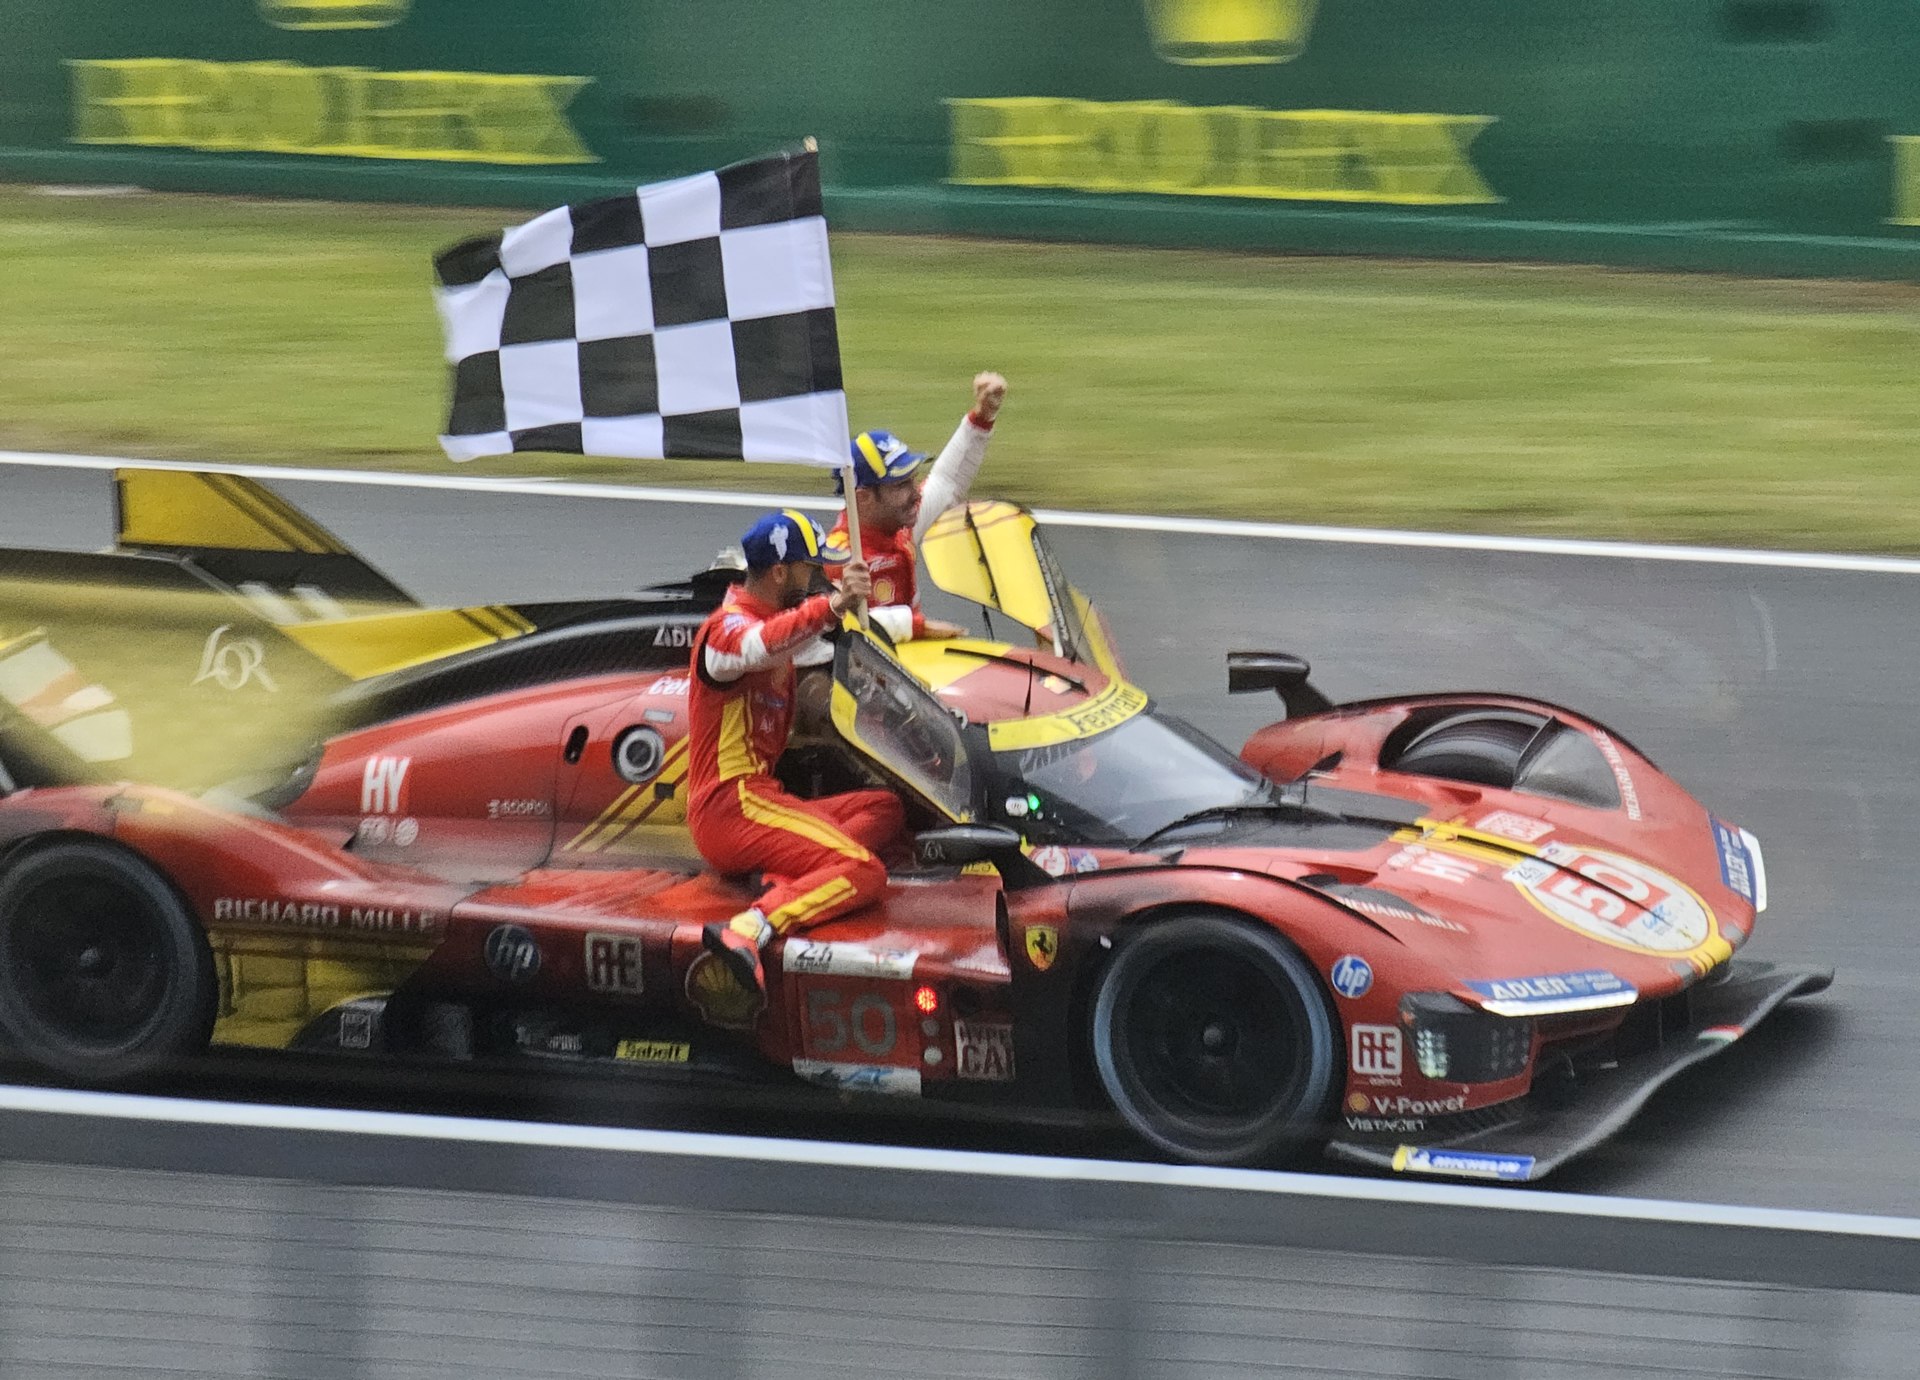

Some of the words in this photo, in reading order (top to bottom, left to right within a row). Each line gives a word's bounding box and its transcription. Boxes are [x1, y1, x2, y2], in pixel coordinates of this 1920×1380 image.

[652, 626, 693, 648] ADL
[361, 756, 411, 813] HY
[1550, 862, 1650, 922] 50
[213, 897, 340, 926] RICHARD
[351, 908, 435, 931] MILLE
[495, 926, 535, 979] hp
[1336, 956, 1369, 997] hp
[1490, 975, 1574, 1000] ADLER
[806, 989, 898, 1057] 50
[1373, 1095, 1467, 1115] V-Power
